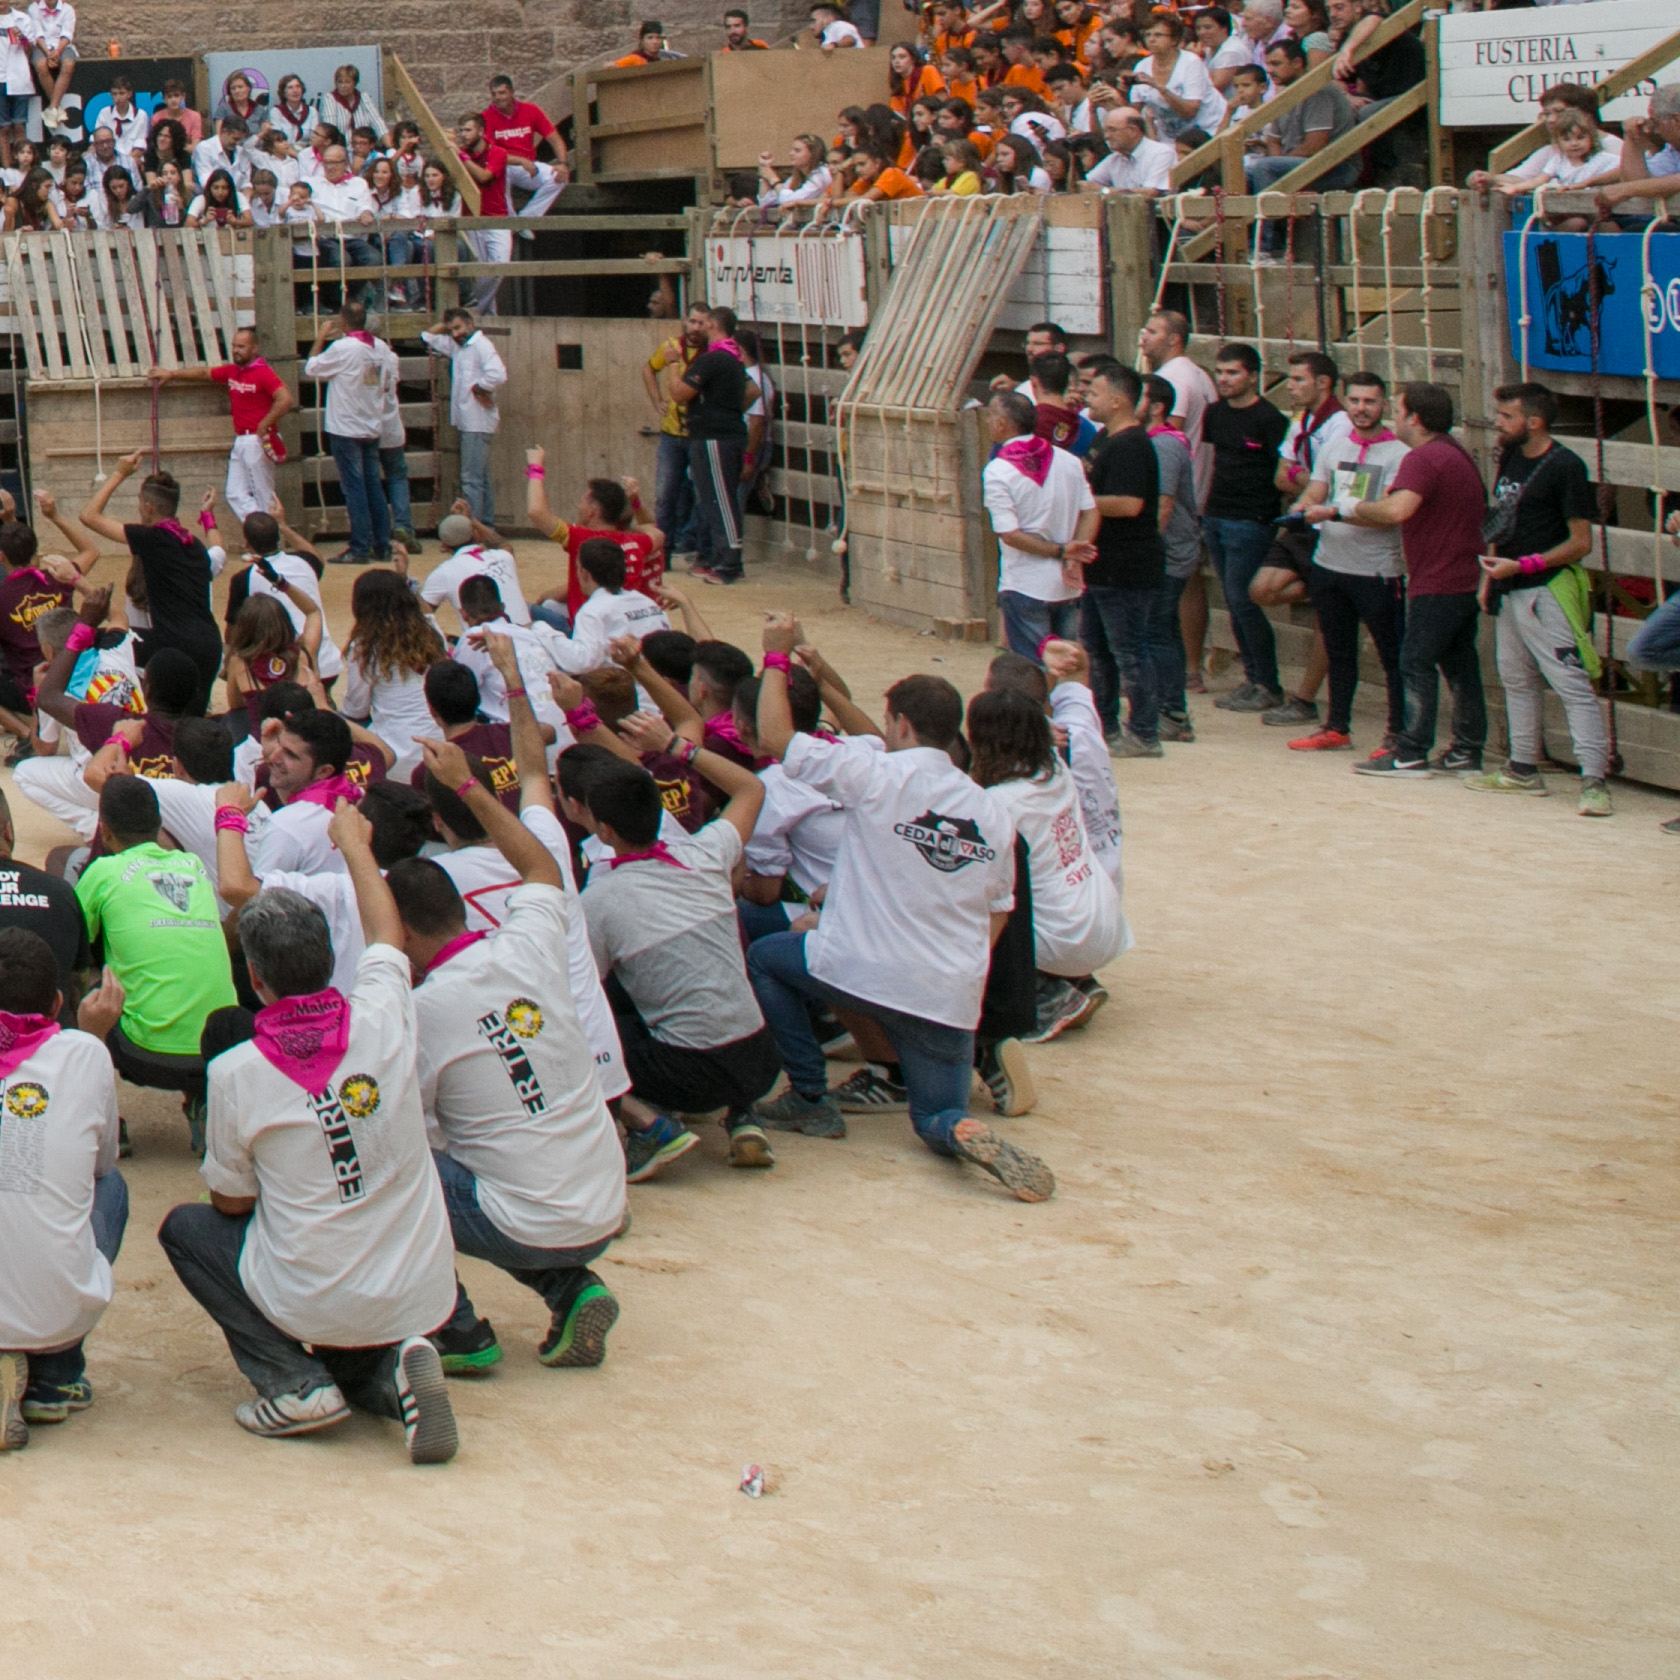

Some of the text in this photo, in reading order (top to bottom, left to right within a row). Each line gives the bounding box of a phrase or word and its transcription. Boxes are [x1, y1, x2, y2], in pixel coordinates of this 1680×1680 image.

[1475, 36, 1578, 65] FUSTERIA
[893, 822, 935, 844] CEDA
[594, 1051, 611, 1065] 10
